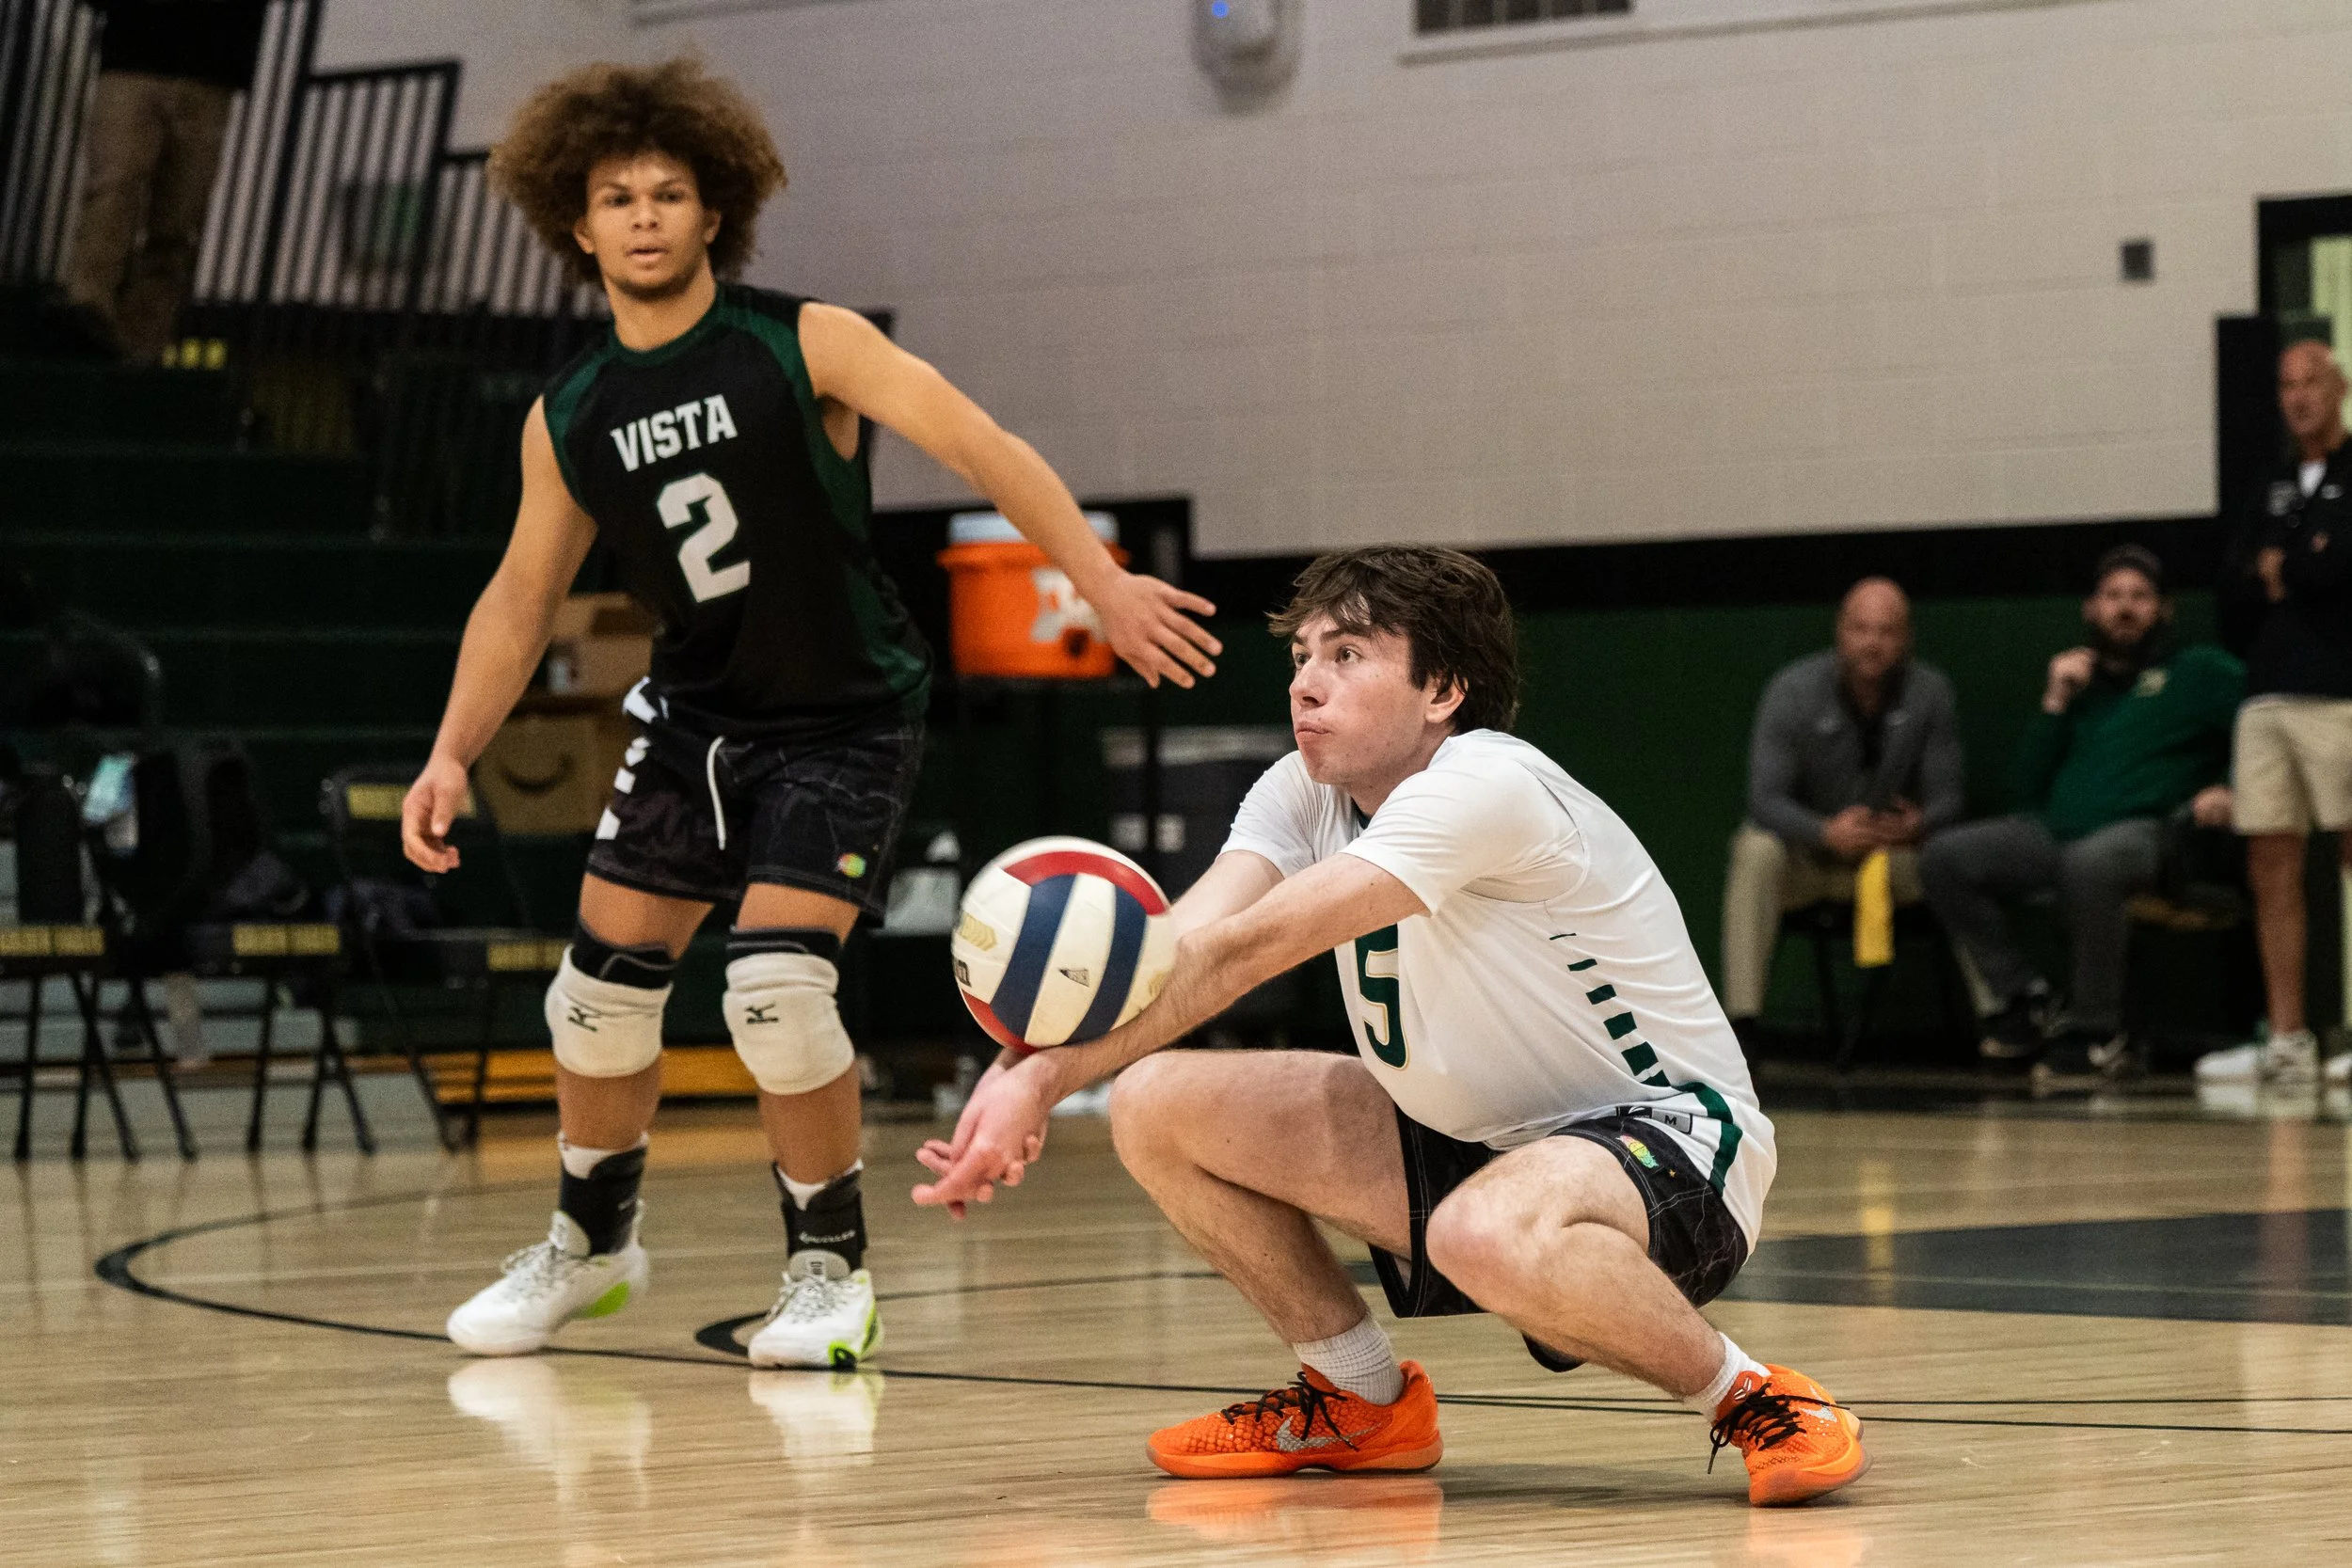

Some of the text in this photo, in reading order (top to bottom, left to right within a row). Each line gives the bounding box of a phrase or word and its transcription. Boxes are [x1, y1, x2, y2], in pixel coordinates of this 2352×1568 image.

[610, 394, 738, 471] VISTA
[657, 472, 751, 603] 2
[1355, 923, 1409, 1069] 5
[1664, 1115, 1677, 1126] M
